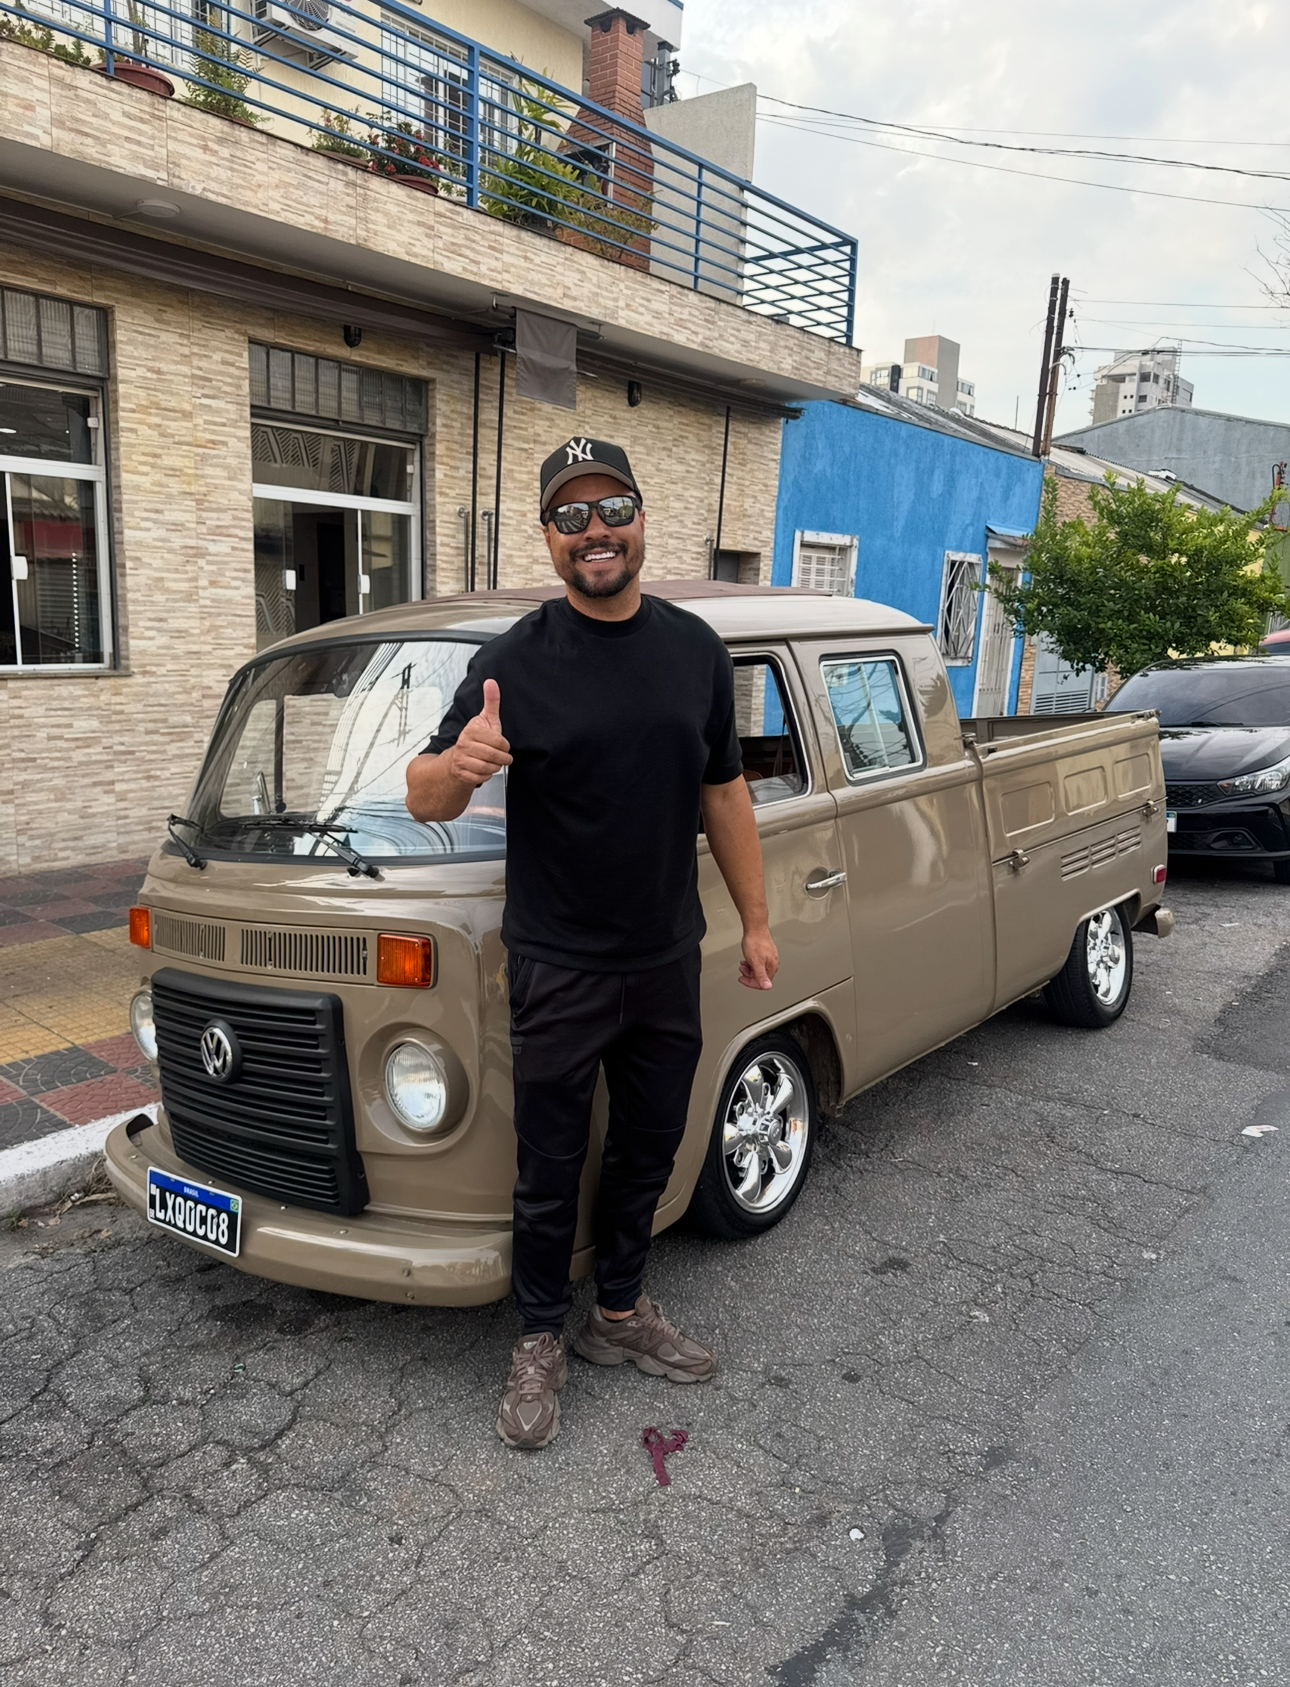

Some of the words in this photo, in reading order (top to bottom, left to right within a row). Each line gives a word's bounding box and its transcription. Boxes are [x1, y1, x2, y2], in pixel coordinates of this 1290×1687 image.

[565, 438, 594, 465] NY
[202, 1029, 229, 1077] VW
[183, 1186, 199, 1198] BRASIL
